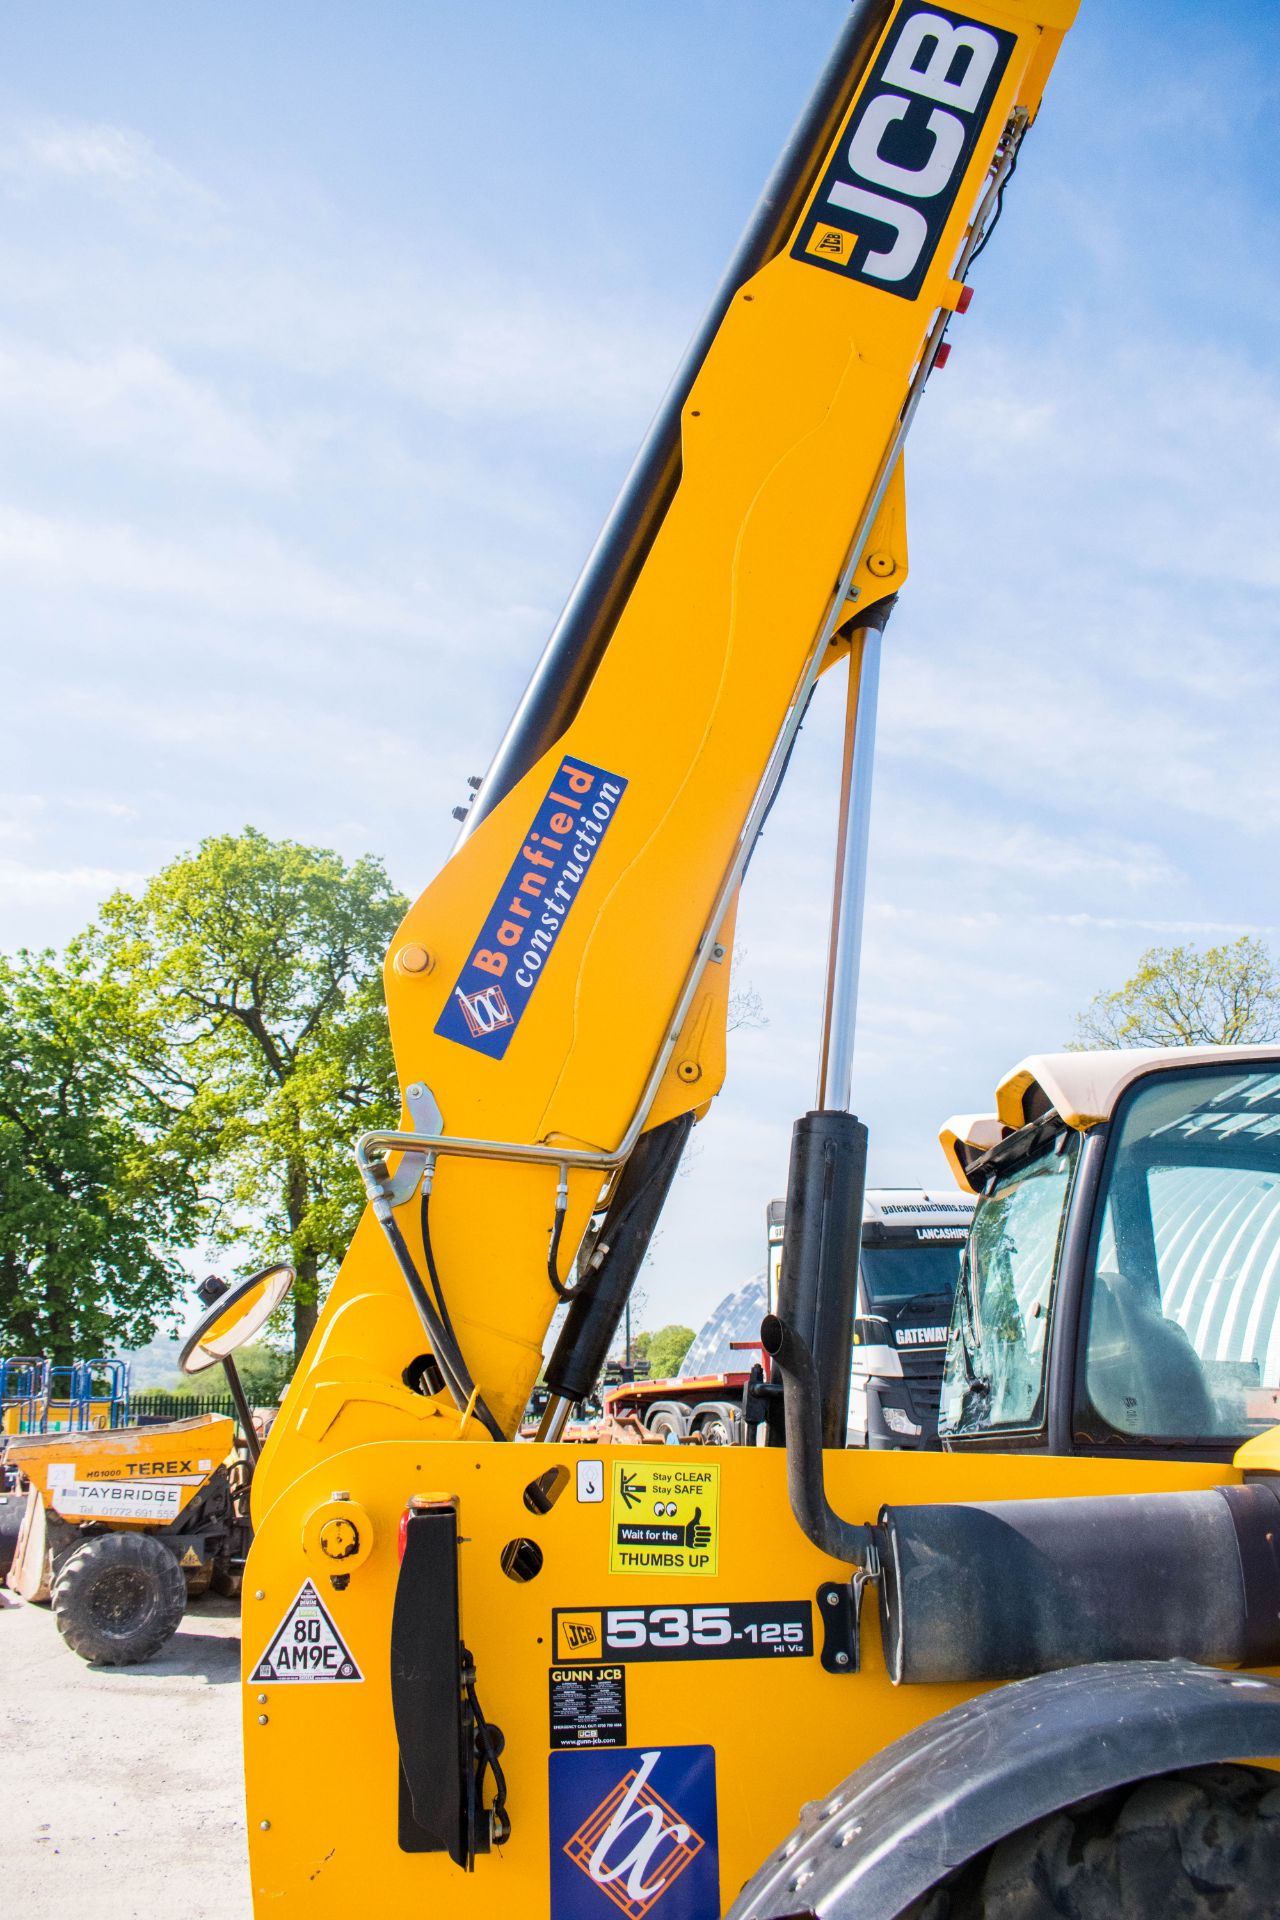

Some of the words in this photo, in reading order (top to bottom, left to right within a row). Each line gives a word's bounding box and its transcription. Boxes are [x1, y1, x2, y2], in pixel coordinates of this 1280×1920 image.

[826, 12, 999, 282] JCB
[819, 232, 842, 254] JCB
[472, 764, 595, 977] Barnfield
[515, 782, 621, 988] construction
[881, 1203, 976, 1215] gatewayauctions.com
[895, 1326, 948, 1345] GATEWAY
[126, 1460, 192, 1476] TEREX
[652, 1473, 672, 1482] Stay
[674, 1472, 711, 1482] CLEAR
[79, 1487, 177, 1502] TAYBRIDGE
[652, 1485, 672, 1495] Stay
[674, 1485, 703, 1495] SAFE
[621, 1529, 644, 1540] Wait
[645, 1529, 660, 1540] for
[662, 1530, 678, 1541] the
[619, 1553, 684, 1567] THUMBS
[688, 1555, 709, 1568] UP
[569, 1624, 595, 1648] JCB
[773, 1644, 784, 1653] Hi
[788, 1643, 804, 1652] Viz
[276, 1645, 338, 1670] AM9E
[552, 1670, 593, 1682] GUNN
[596, 1668, 622, 1680] JCB
[560, 1738, 616, 1747] www.gunn-jcb.com
